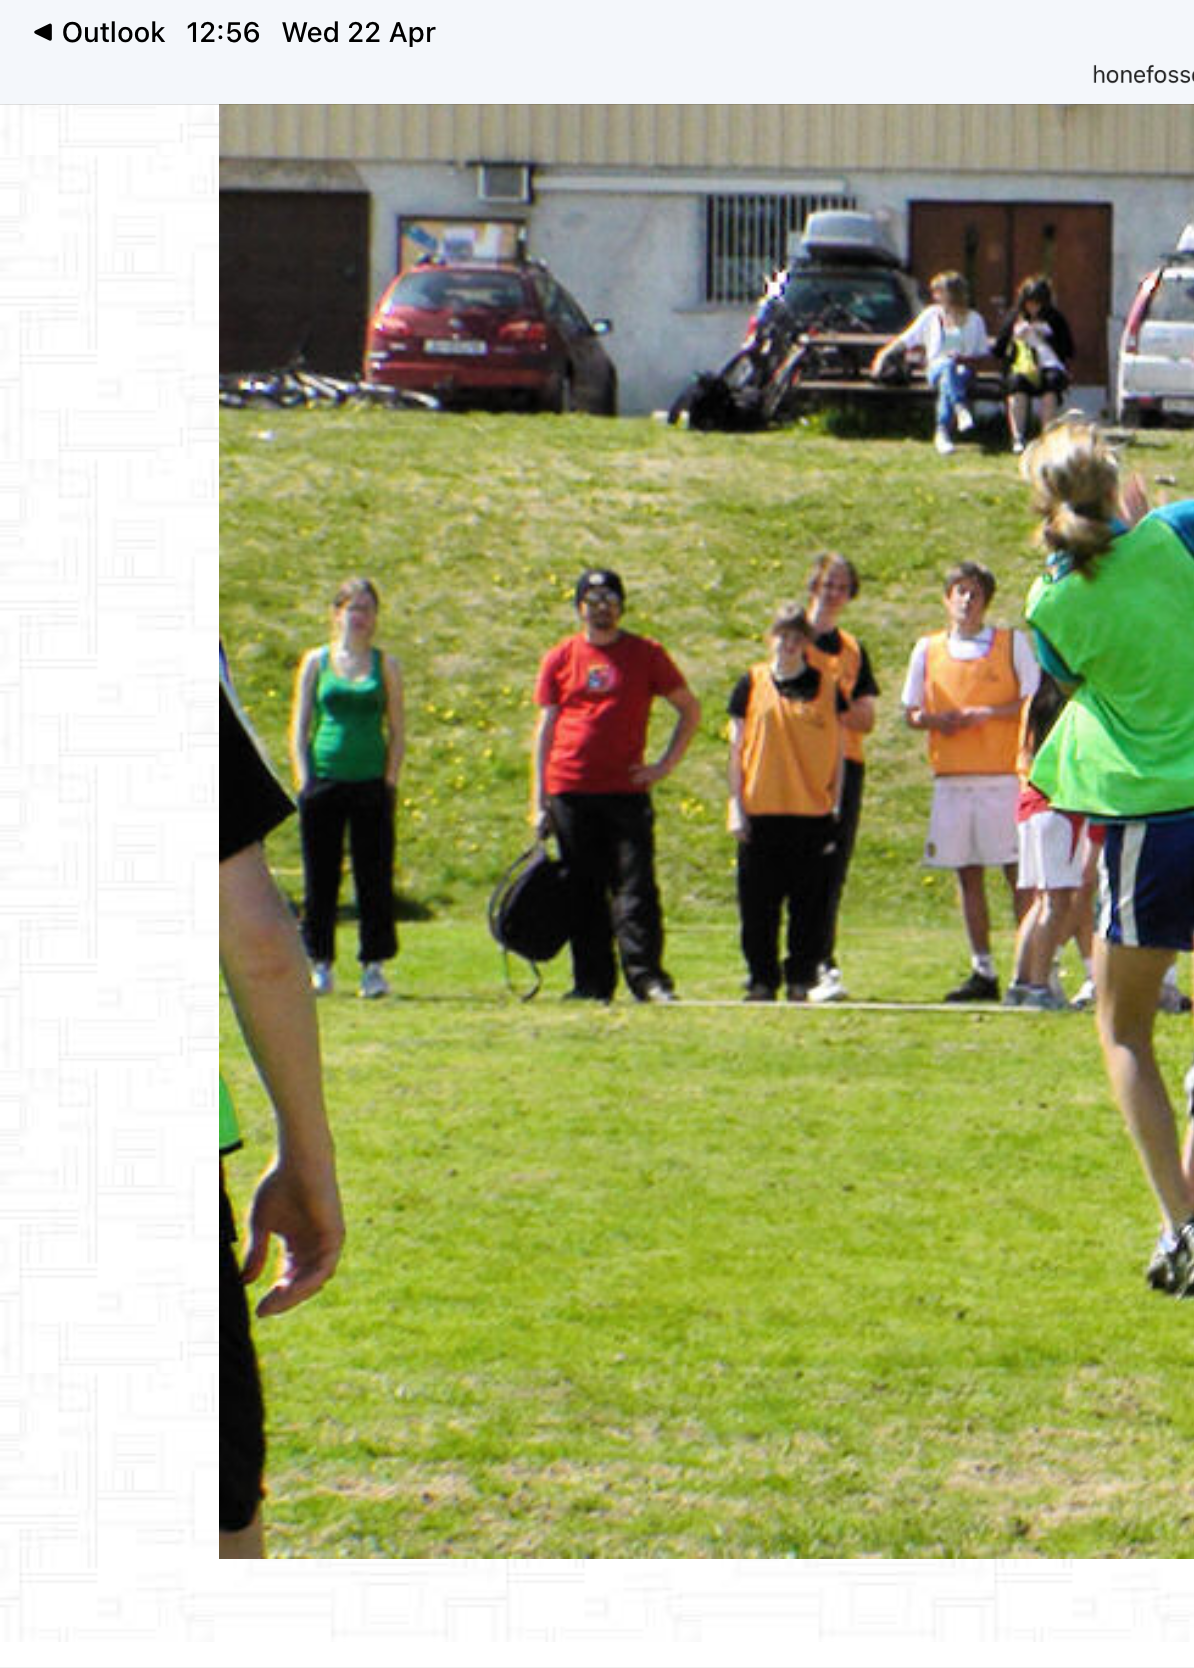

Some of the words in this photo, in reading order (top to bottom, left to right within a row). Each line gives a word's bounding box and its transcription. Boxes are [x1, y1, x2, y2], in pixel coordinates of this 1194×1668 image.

[62, 20, 166, 44] Outlook
[187, 21, 260, 44] 12:56
[281, 20, 339, 44] Wed
[348, 21, 381, 43] 22
[389, 21, 437, 48] Apr
